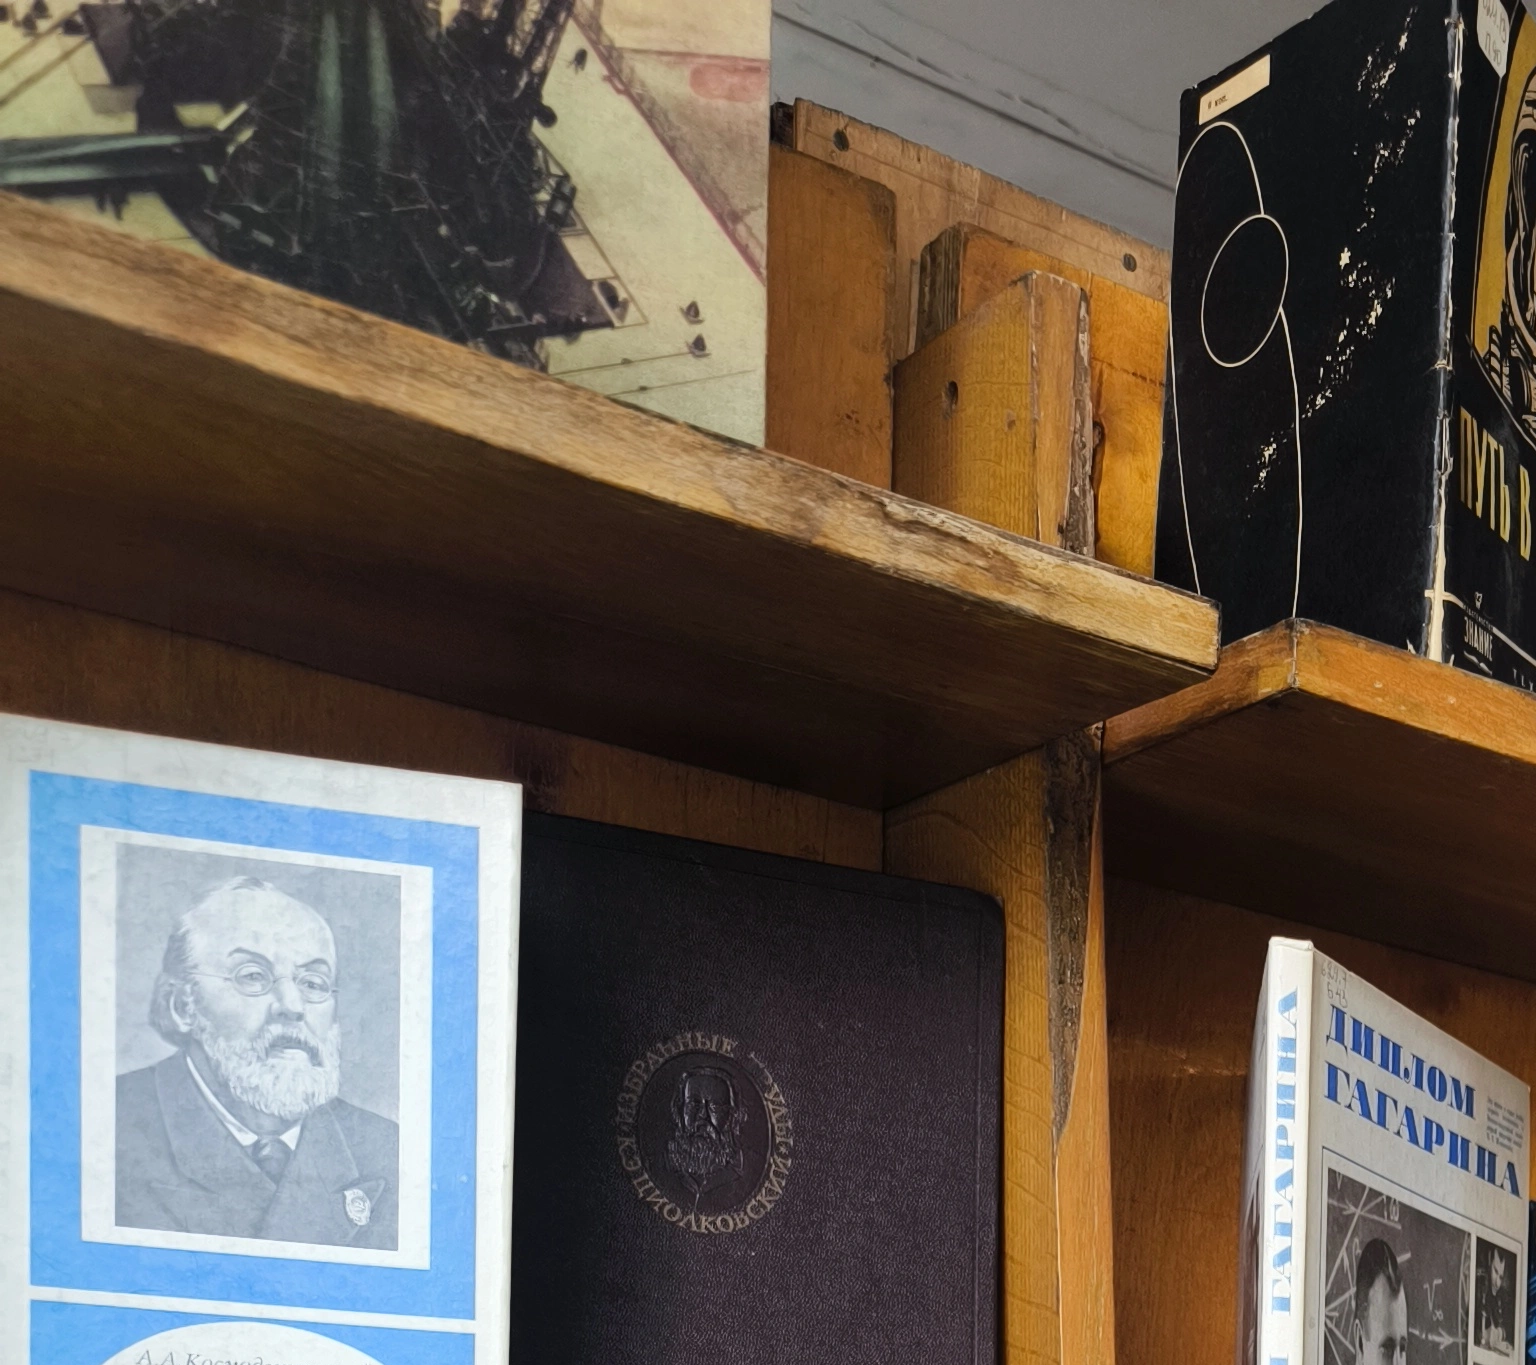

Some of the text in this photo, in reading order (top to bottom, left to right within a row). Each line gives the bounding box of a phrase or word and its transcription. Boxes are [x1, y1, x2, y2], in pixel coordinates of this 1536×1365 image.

[1460, 405, 1509, 543] ПУТЬ
[1519, 464, 1531, 561] В
[1464, 616, 1493, 662] ЗНАНИЕ
[1324, 1060, 1523, 1199] ГАГАРИНА
[1326, 1003, 1476, 1120] ДИПЛОМ
[1271, 986, 1299, 1316] ГАГАРИНА
